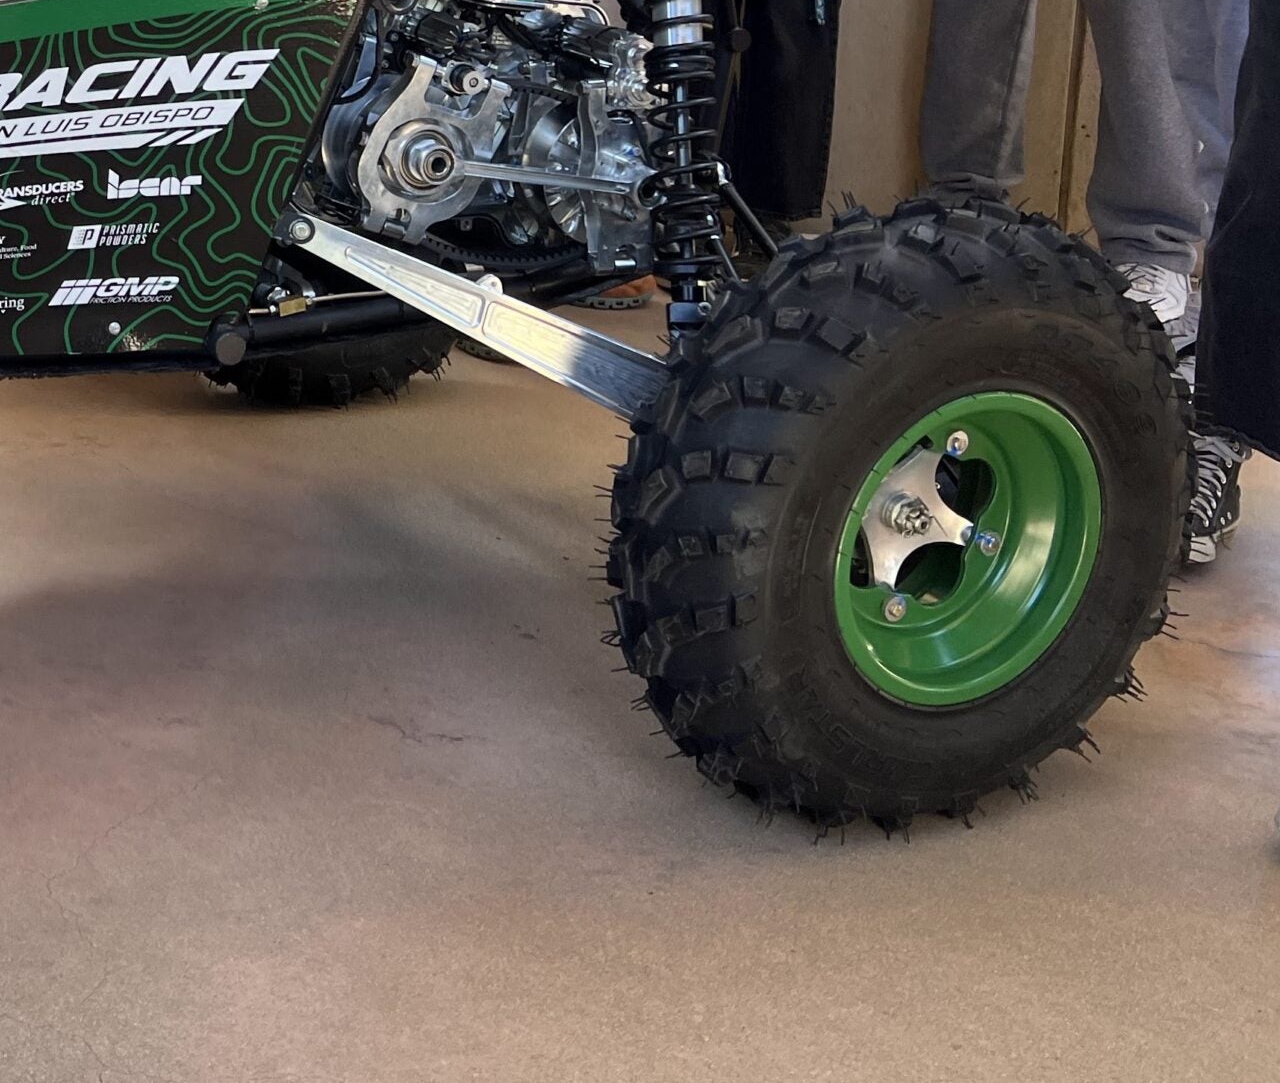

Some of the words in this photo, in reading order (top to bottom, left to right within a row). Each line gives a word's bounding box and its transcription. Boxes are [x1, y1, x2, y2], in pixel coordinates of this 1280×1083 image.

[24, 116, 90, 136] LUIS
[100, 104, 216, 127] OBISPO
[30, 194, 71, 207] direct
[102, 222, 160, 236] PRISMATIC
[20, 243, 37, 251] Food
[99, 234, 148, 247] POWDERS
[3, 251, 32, 260] Sciences
[95, 275, 180, 298] GMP
[89, 295, 127, 305] FRICTION
[126, 294, 173, 304] PRODUCTS
